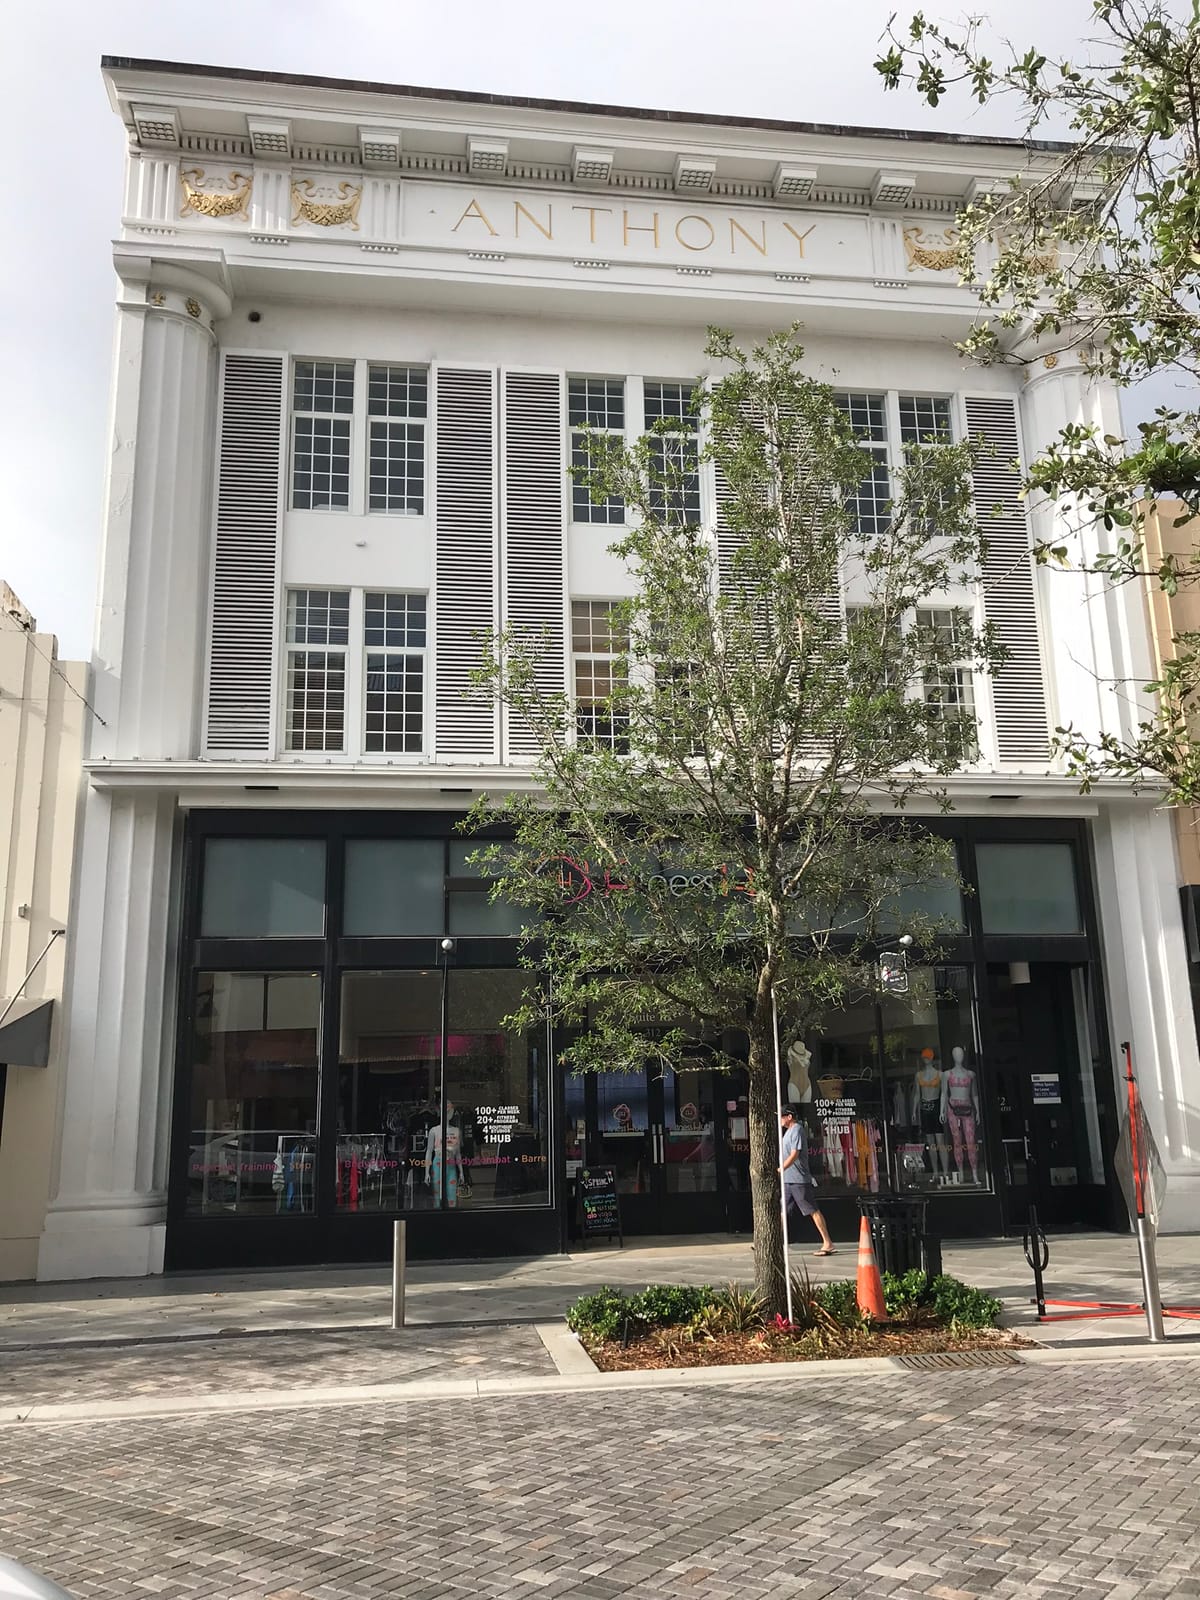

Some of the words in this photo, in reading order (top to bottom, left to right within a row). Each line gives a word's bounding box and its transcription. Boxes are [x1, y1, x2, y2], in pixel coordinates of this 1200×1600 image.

[451, 198, 817, 258] ANTHONY
[814, 1099, 835, 1108] 100+
[474, 1106, 497, 1115] 100+
[816, 1107, 833, 1116] 20+
[476, 1115, 494, 1124] 20+
[482, 1125, 489, 1134] 4
[521, 1154, 547, 1163] Barre
